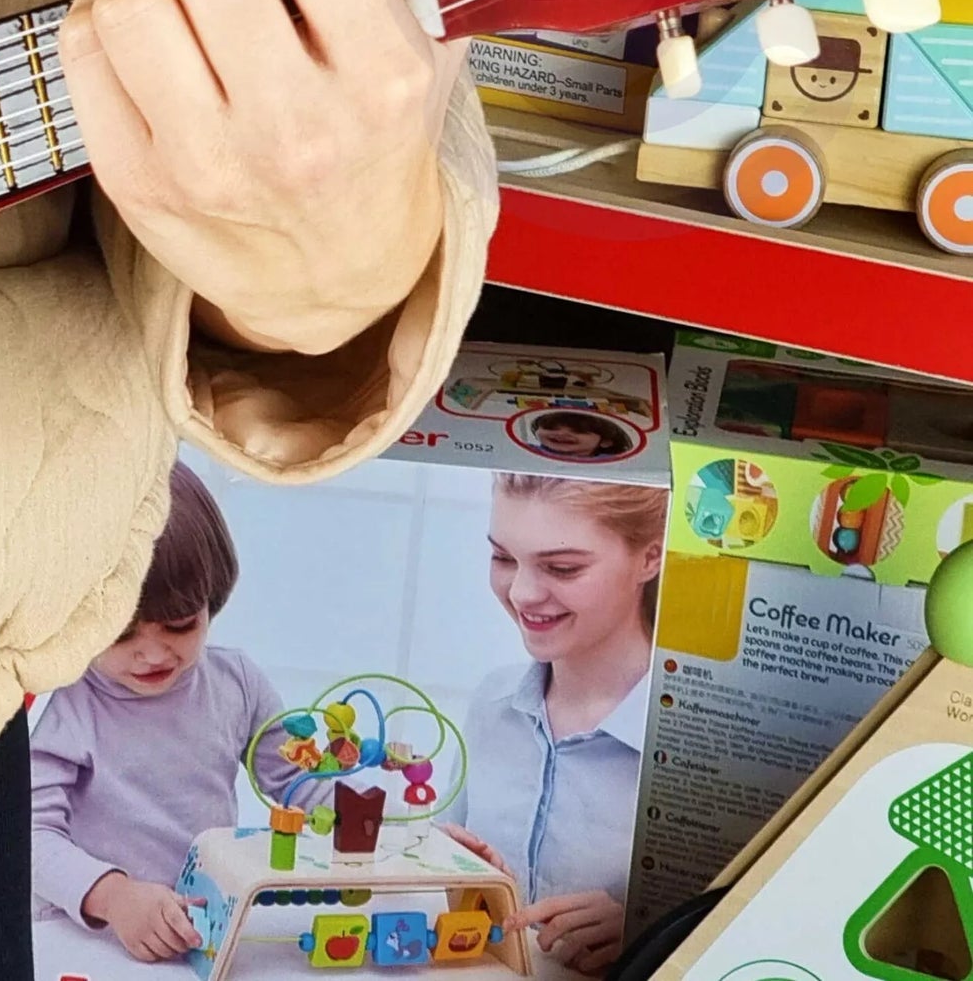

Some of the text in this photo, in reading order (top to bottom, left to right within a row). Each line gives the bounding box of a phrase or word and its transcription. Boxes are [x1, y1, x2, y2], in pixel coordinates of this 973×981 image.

[470, 42, 543, 67] WARNING:
[476, 72, 589, 102] children under 3 years.
[596, 83, 622, 98] Parts
[454, 441, 494, 452] 5052
[749, 597, 820, 629] Coffee
[826, 613, 901, 647] Maker
[744, 635, 781, 651] spoons
[782, 643, 803, 656] and
[804, 647, 839, 664] coffee
[840, 655, 874, 670] beans.
[876, 662, 897, 676] The
[746, 623, 770, 637] Let's
[771, 628, 800, 643] make
[802, 637, 809, 645] a
[811, 639, 829, 651] cup
[831, 640, 843, 652] of
[844, 644, 880, 661] coffee.
[883, 652, 903, 666] This
[742, 658, 830, 684] the perfect brew!
[743, 646, 776, 662] coffee
[779, 653, 823, 670] machine
[826, 665, 864, 682] making
